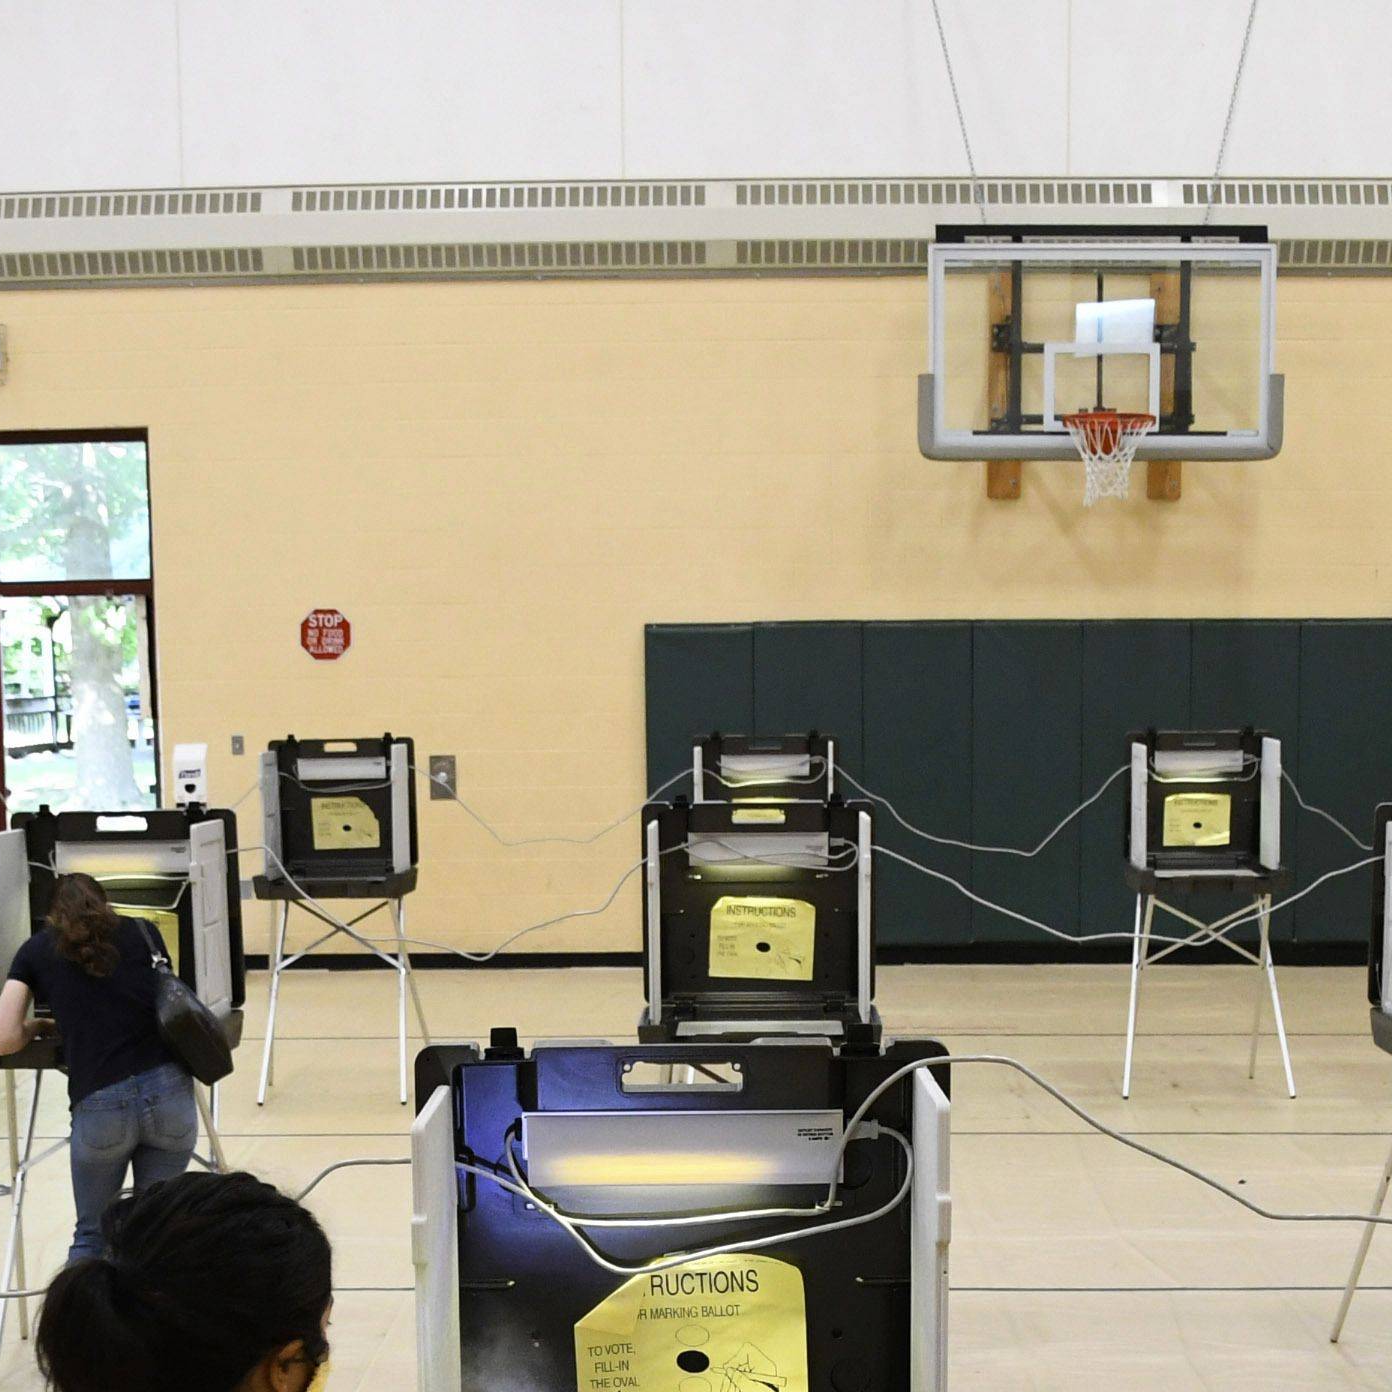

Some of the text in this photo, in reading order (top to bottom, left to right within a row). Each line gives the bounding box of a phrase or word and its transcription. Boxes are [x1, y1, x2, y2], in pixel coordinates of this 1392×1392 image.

[308, 613, 343, 628] STOP
[726, 905, 796, 918] INSTRUCTIONS
[642, 1269, 759, 1297] RUCTIONS
[650, 1306, 698, 1319] MARKING
[701, 1304, 740, 1317] BALLOT
[588, 1342, 636, 1357] TO VOTE,
[594, 1360, 630, 1373] FILL-IN
[590, 1376, 641, 1389] THE OVAL
